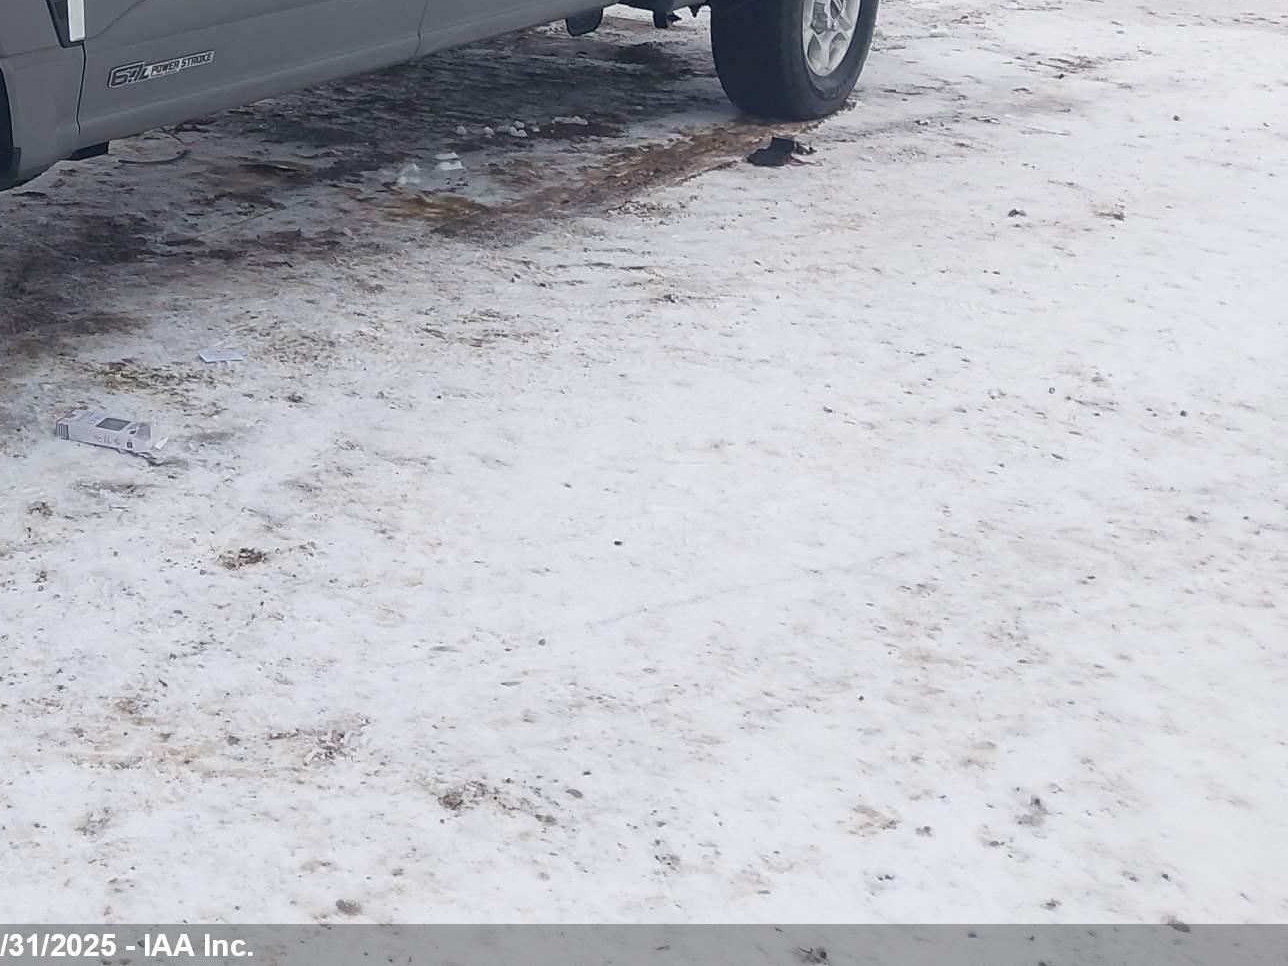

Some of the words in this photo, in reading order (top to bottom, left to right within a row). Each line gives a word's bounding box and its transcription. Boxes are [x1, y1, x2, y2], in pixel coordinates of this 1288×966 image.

[110, 63, 150, 86] 6.7L
[152, 60, 181, 75] POWER
[180, 53, 212, 68] STROKE
